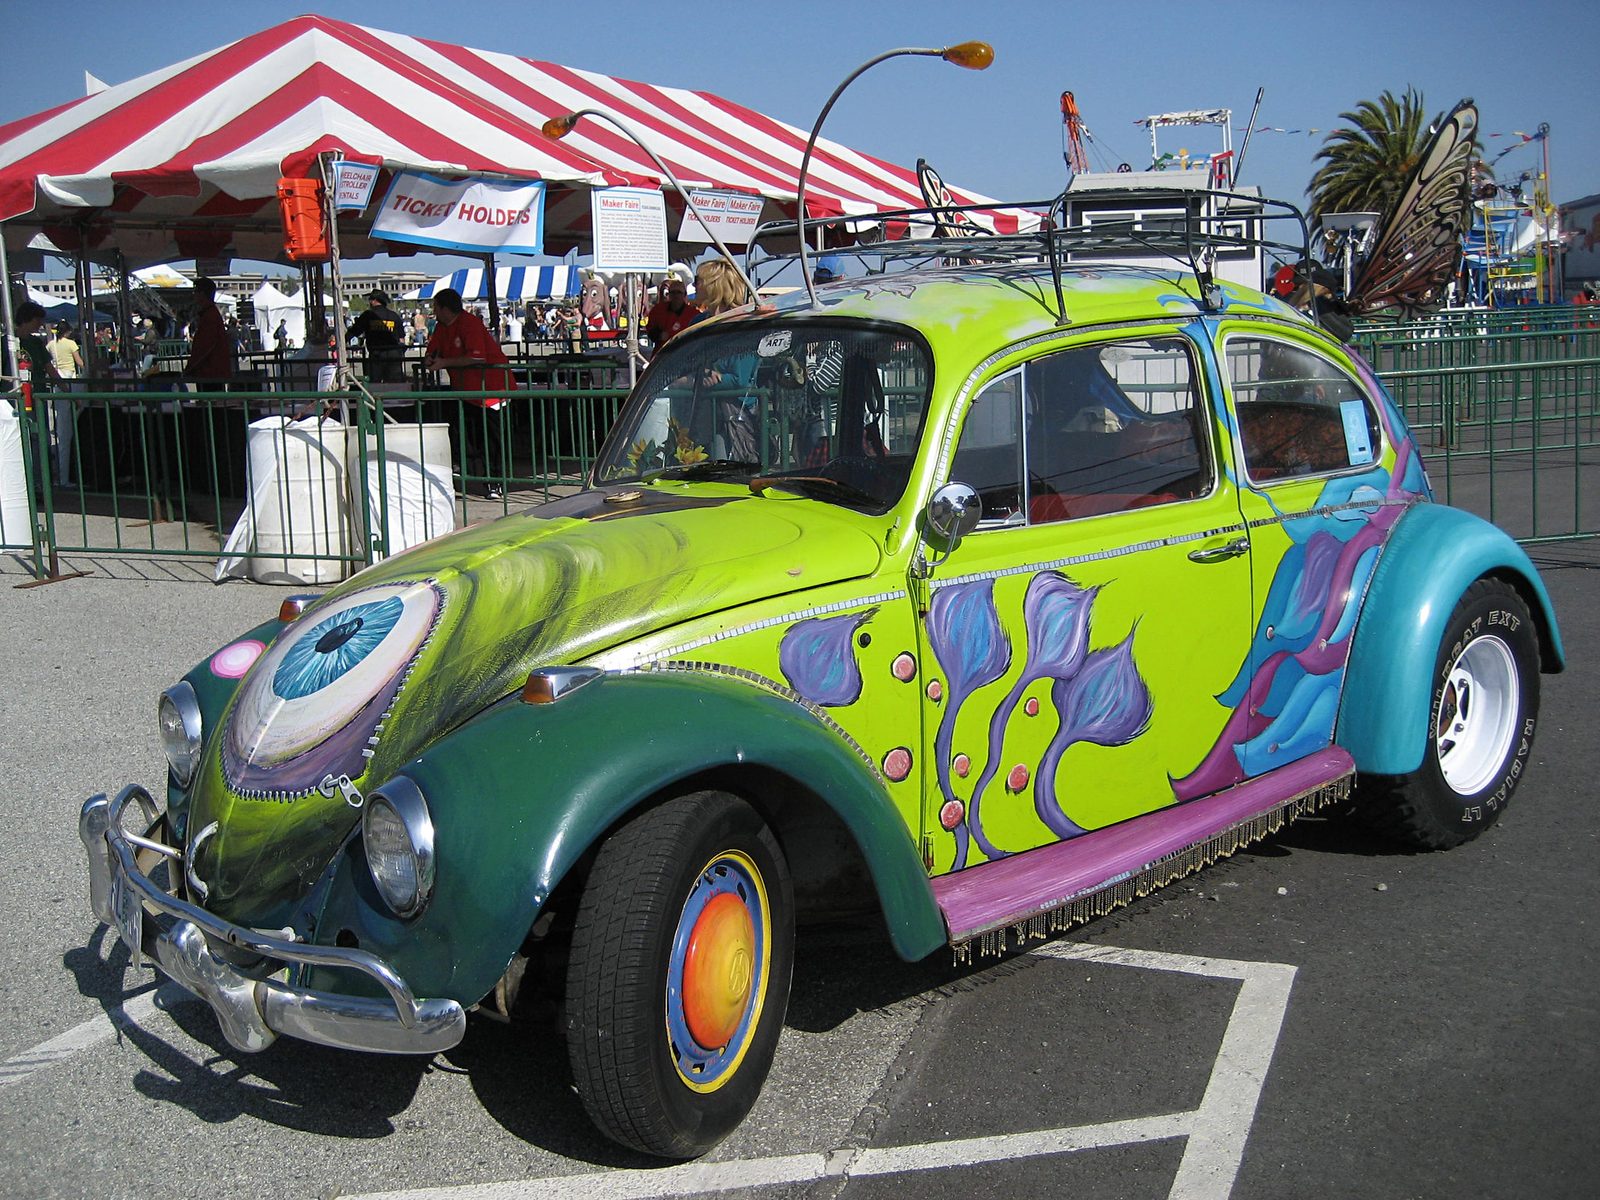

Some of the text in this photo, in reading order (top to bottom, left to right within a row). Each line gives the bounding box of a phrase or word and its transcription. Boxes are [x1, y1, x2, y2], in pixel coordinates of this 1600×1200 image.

[602, 199, 624, 208] Maker
[624, 200, 640, 209] Faire
[692, 195, 726, 209] Maker Faire
[730, 200, 748, 210] Maker
[393, 195, 531, 226] TICKET HOLDERS
[766, 339, 784, 347] ART
[1487, 609, 1521, 633] EXT
[1461, 718, 1536, 822] RADIAL LT
